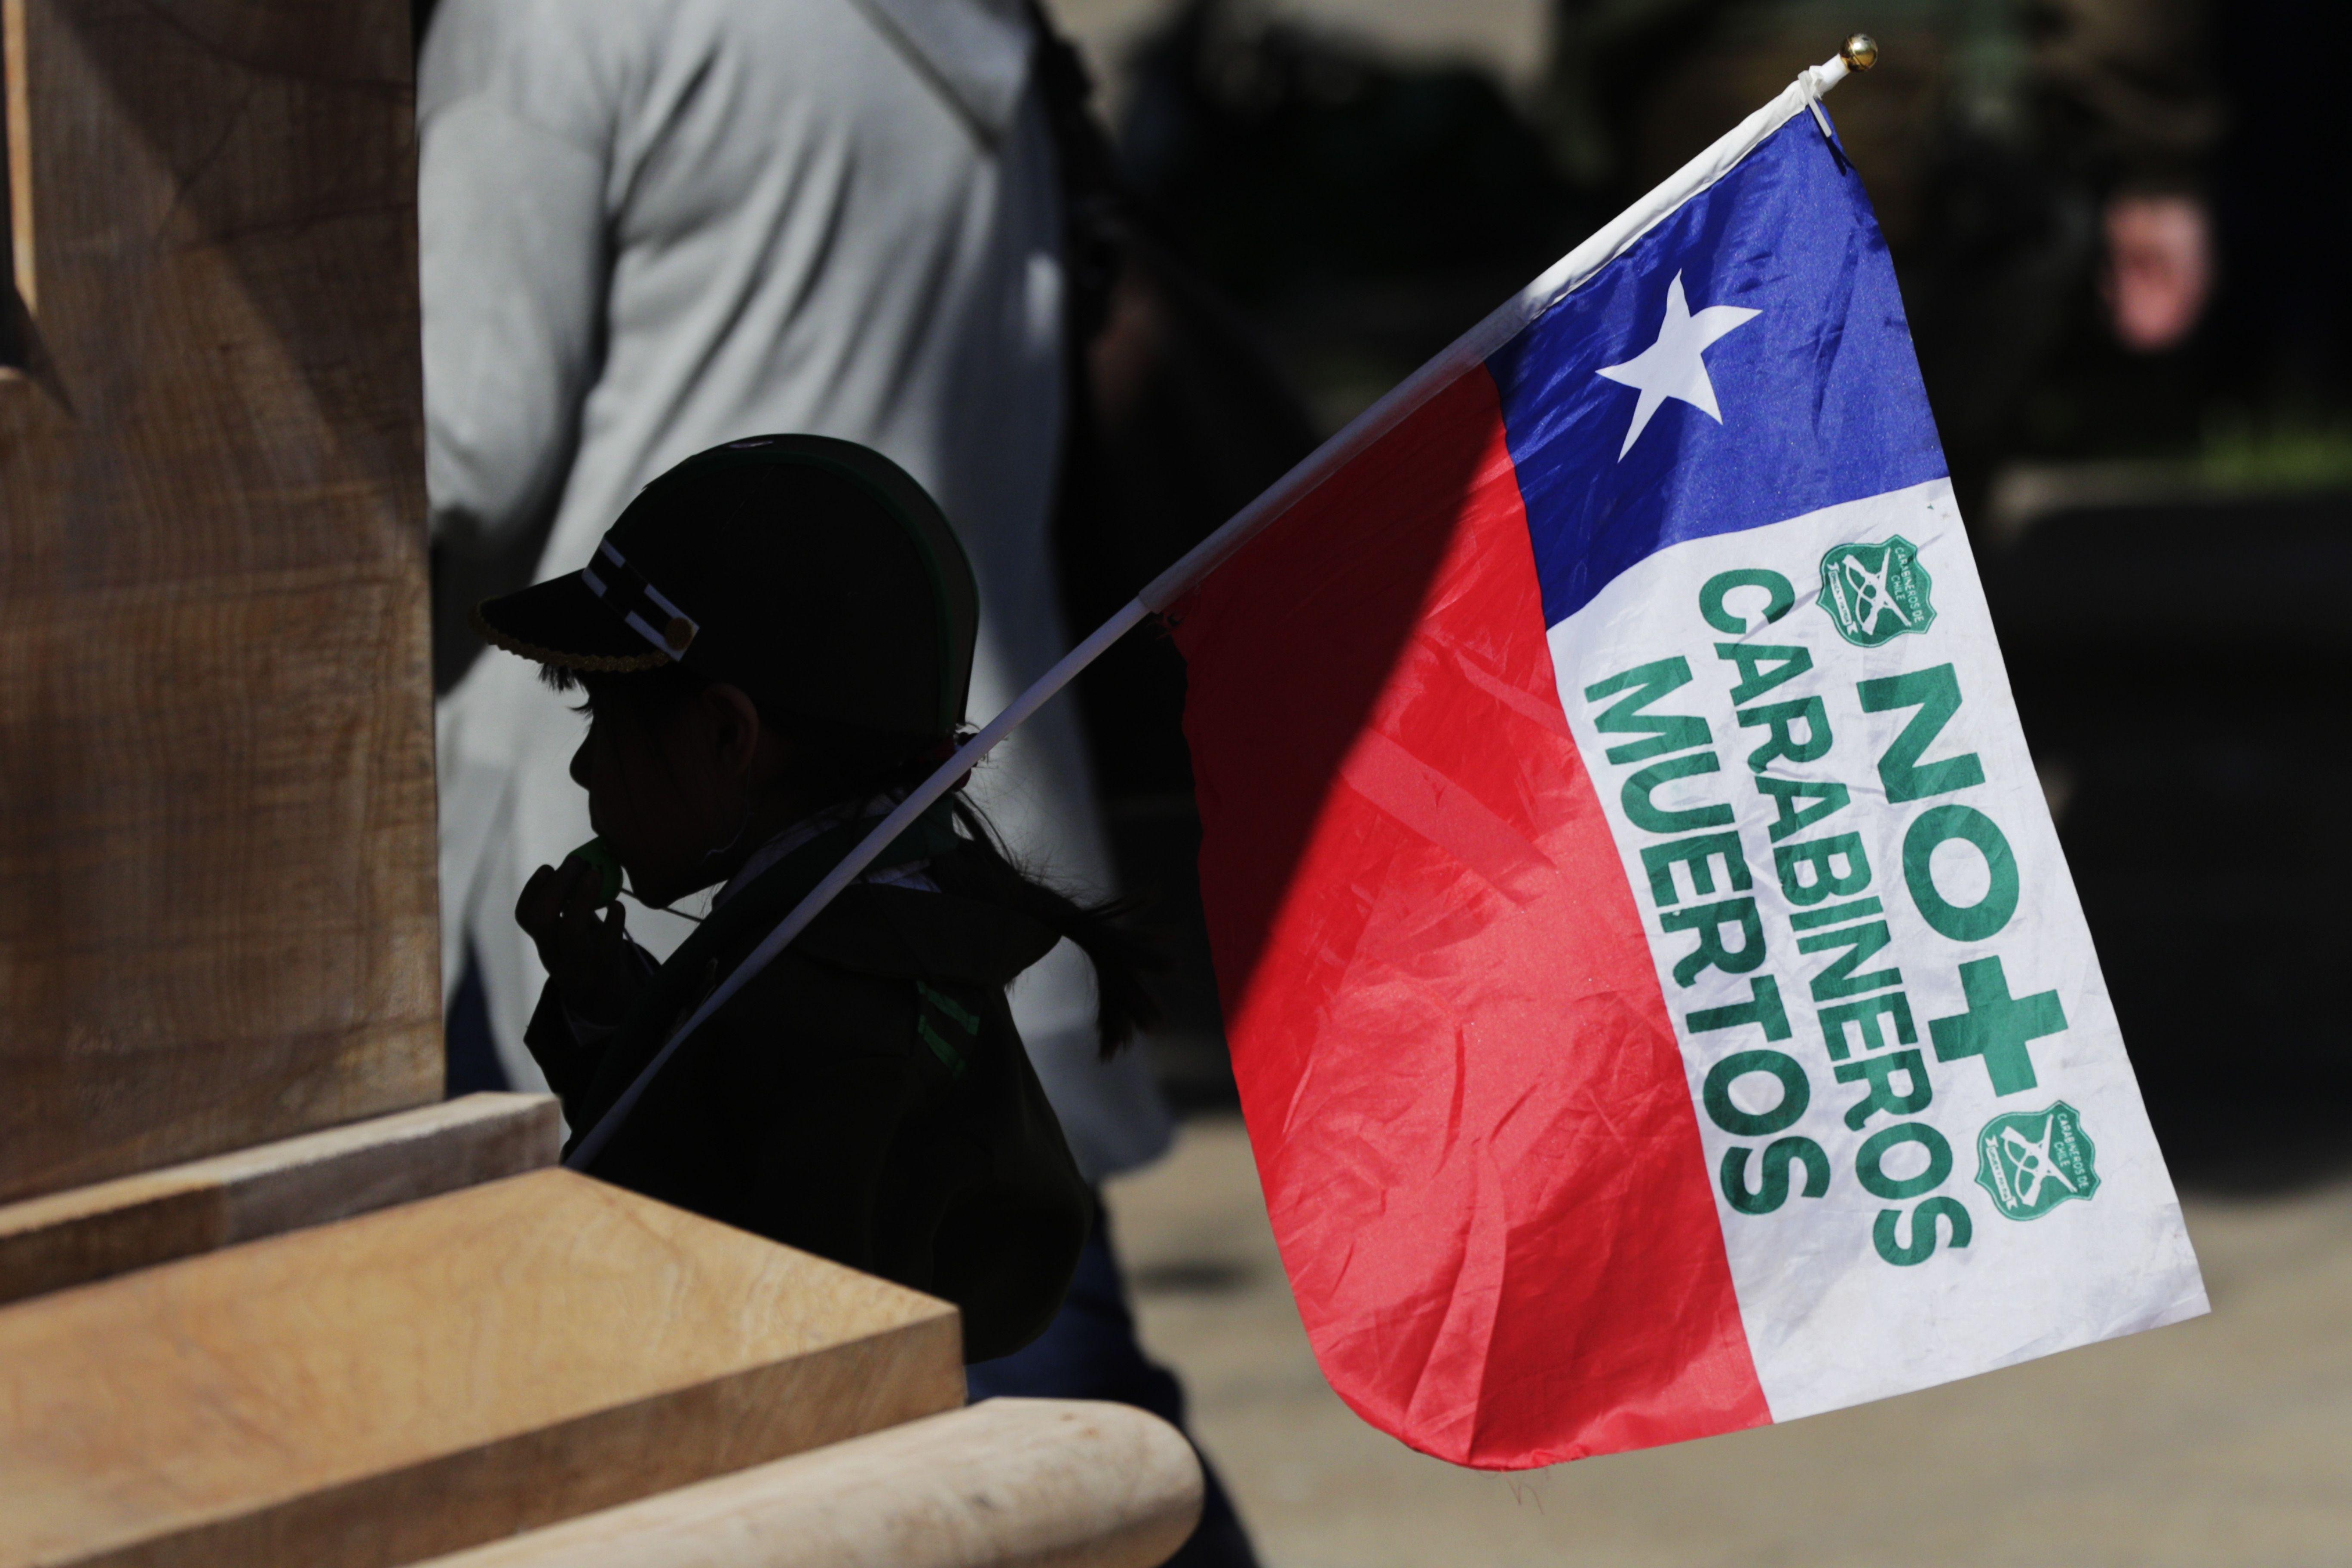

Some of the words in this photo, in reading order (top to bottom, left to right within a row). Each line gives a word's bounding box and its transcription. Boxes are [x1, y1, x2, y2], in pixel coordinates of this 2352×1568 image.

[1891, 575, 1905, 601] CHILE
[1912, 608, 1924, 623] DE
[1585, 655, 1830, 1216] MUERTOS
[1699, 568, 1972, 1267] CARABINEROS
[2054, 1141, 2070, 1167] CHILE
[2057, 1113, 2085, 1175] CARABINEROS
[2077, 1174, 2089, 1188] DE
